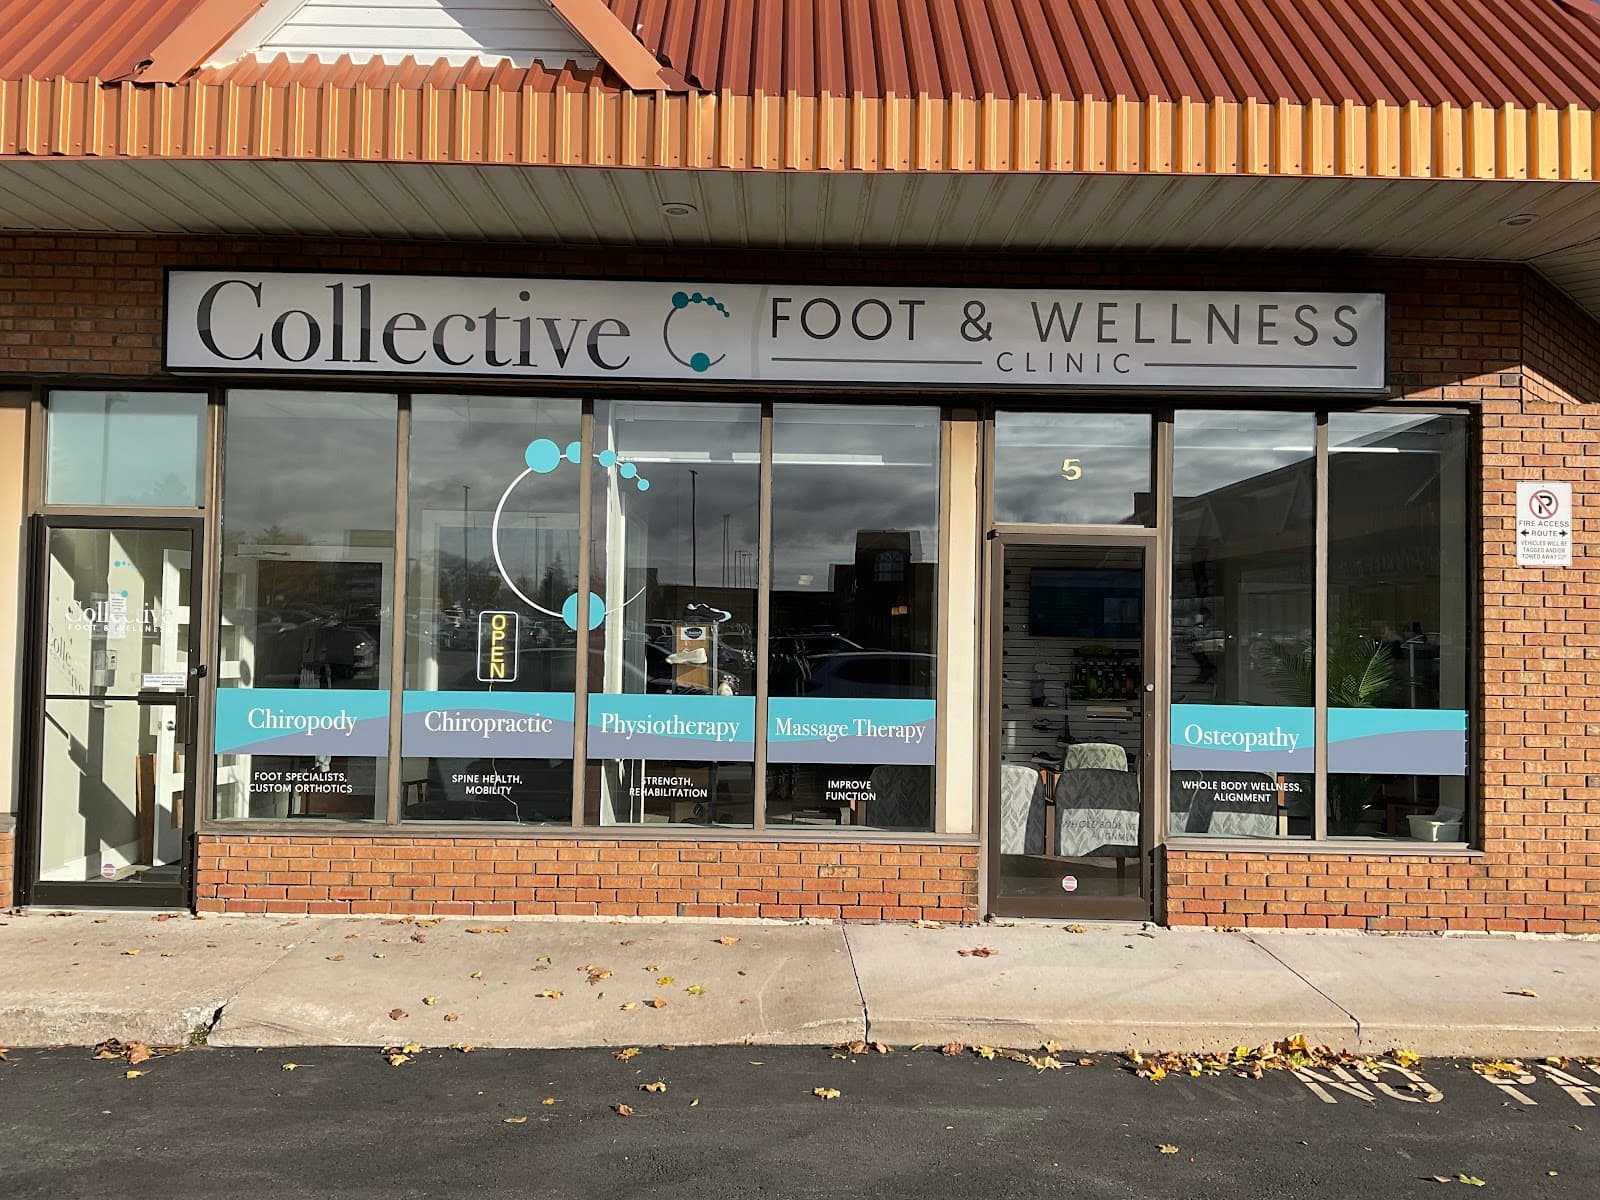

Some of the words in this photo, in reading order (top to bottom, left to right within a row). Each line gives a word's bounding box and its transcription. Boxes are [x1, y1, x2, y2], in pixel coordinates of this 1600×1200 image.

[197, 279, 631, 371] Collective
[771, 297, 926, 341] FOOT
[960, 300, 993, 343] &
[1031, 302, 1359, 347] WELLNESS
[996, 351, 1131, 374] CLINIC
[1061, 458, 1082, 481] 5
[1538, 520, 1570, 528] ACCESS
[489, 614, 507, 679] OPEN
[247, 707, 357, 737] Chiropody
[424, 710, 553, 738] Chiropractic
[599, 712, 741, 743] Physiotherapy
[775, 717, 849, 743] Massage
[852, 718, 927, 744] Therapy
[1184, 723, 1301, 753] Osteopathy
[254, 772, 282, 782] FOOT
[285, 772, 348, 784] SPECIALISTS,
[451, 774, 480, 784] SPINE
[482, 774, 523, 785] HEALTH,
[641, 776, 695, 788] STRENGTH,
[827, 780, 872, 790] IMPROVE
[1181, 780, 1218, 791] WHOLE
[1220, 780, 1248, 791] BODY
[1250, 781, 1303, 793] WELLNESS,
[248, 783, 292, 793] CUSTOM
[294, 784, 353, 794] ORTHOTICS
[465, 785, 512, 796] MOBILITY
[629, 787, 708, 798] REHABILITATION
[825, 791, 877, 801] FUNCTION
[1213, 792, 1271, 803] ALIGNMENT
[1290, 1062, 1444, 1103] NO
